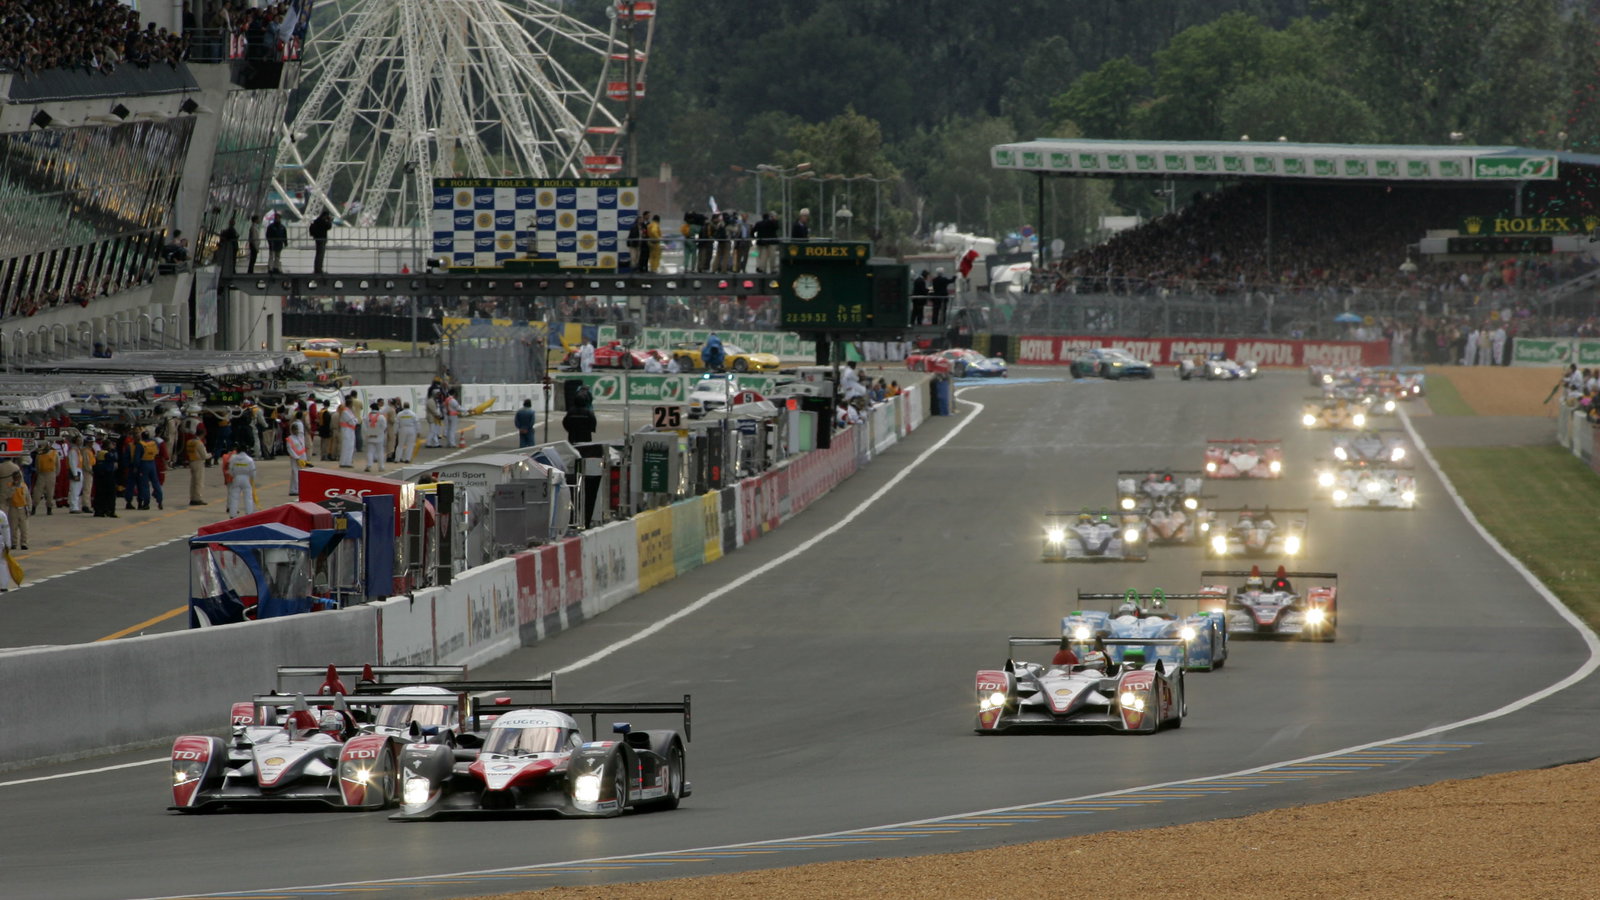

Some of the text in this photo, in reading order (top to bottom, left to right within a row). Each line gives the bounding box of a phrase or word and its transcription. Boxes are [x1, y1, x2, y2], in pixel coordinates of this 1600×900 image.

[1478, 164, 1518, 178] Sarthe
[1494, 217, 1570, 234] ROLEX
[805, 246, 849, 257] ROLEX
[1020, 340, 1054, 361] MOTUL
[1234, 342, 1293, 364] MOTUL
[268, 380, 279, 389] 78
[630, 382, 659, 396] Sarthe
[745, 394, 752, 403] 5
[140, 409, 153, 419] 32
[654, 407, 680, 427] 25
[440, 471, 486, 479] Audi Sport
[542, 482, 548, 498] 3
[977, 682, 1001, 690] TDI
[1124, 682, 1150, 690] TDI
[232, 715, 255, 724] TD
[174, 750, 201, 760] TDI
[346, 749, 376, 759] TDI
